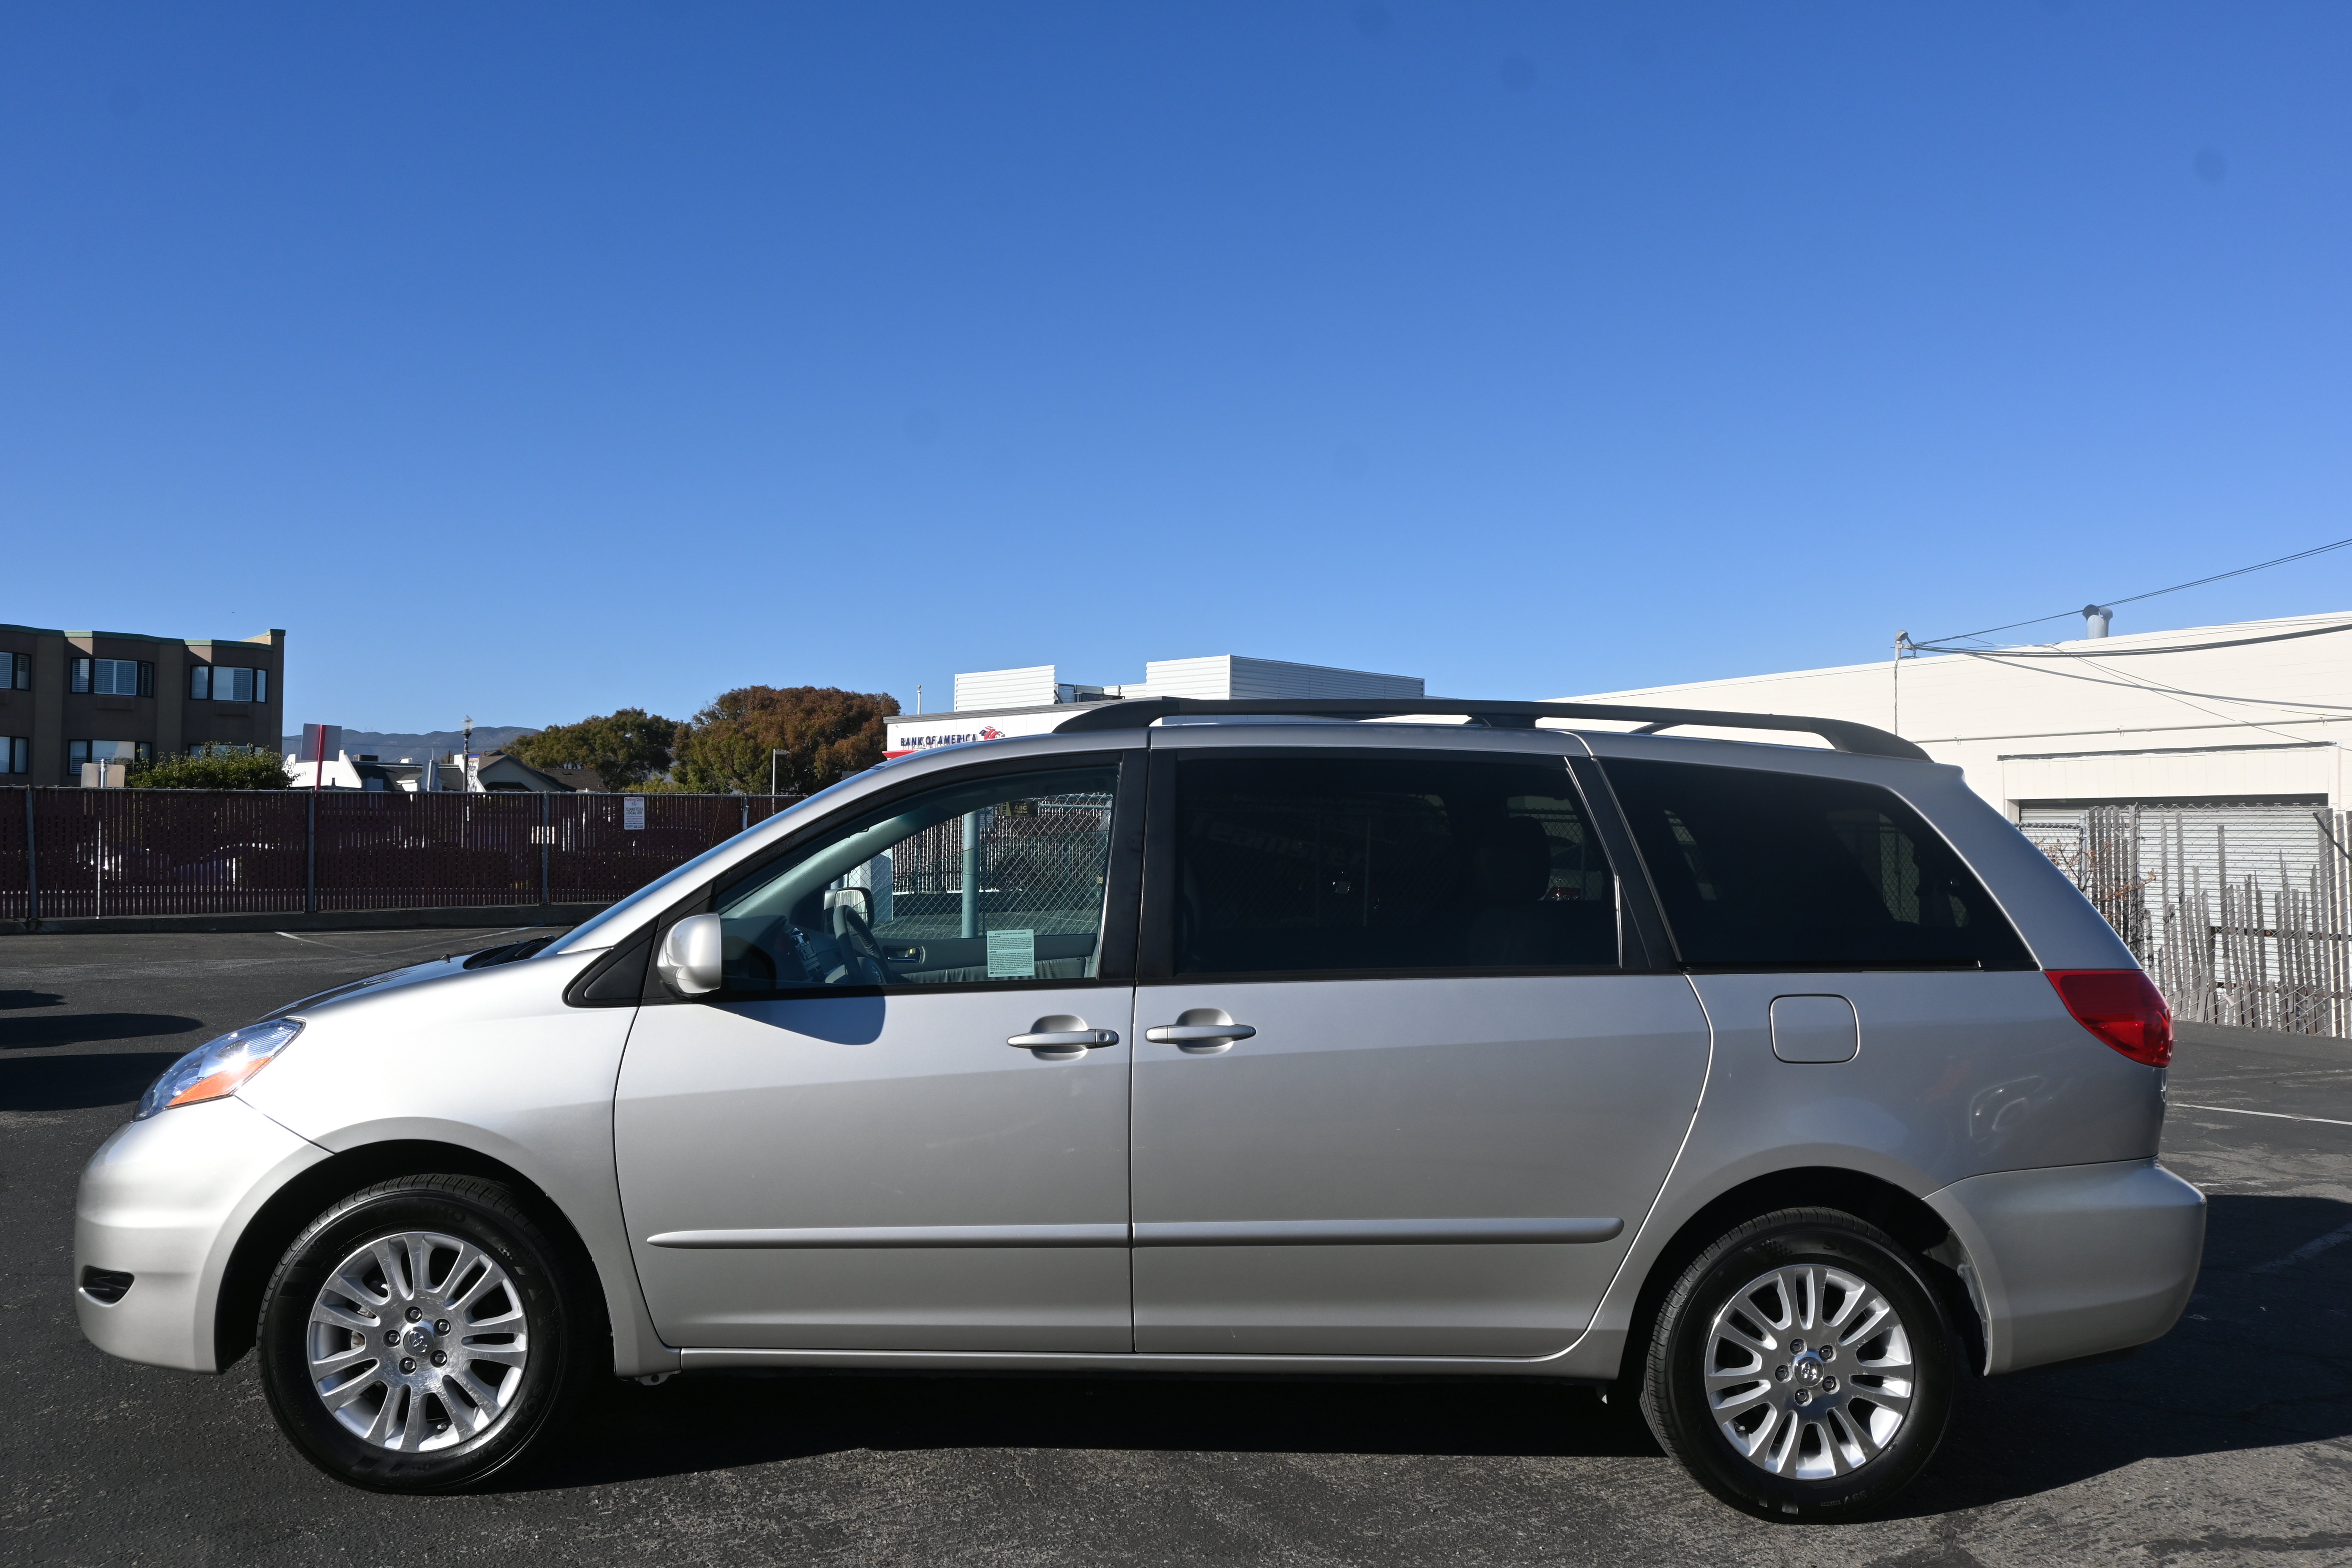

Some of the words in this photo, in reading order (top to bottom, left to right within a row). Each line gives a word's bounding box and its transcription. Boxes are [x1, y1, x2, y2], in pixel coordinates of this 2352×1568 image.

[901, 737, 923, 746] BANK
[926, 736, 936, 745] OF
[937, 734, 977, 744] AMERICA
[485, 1380, 546, 1456] SOLUS
